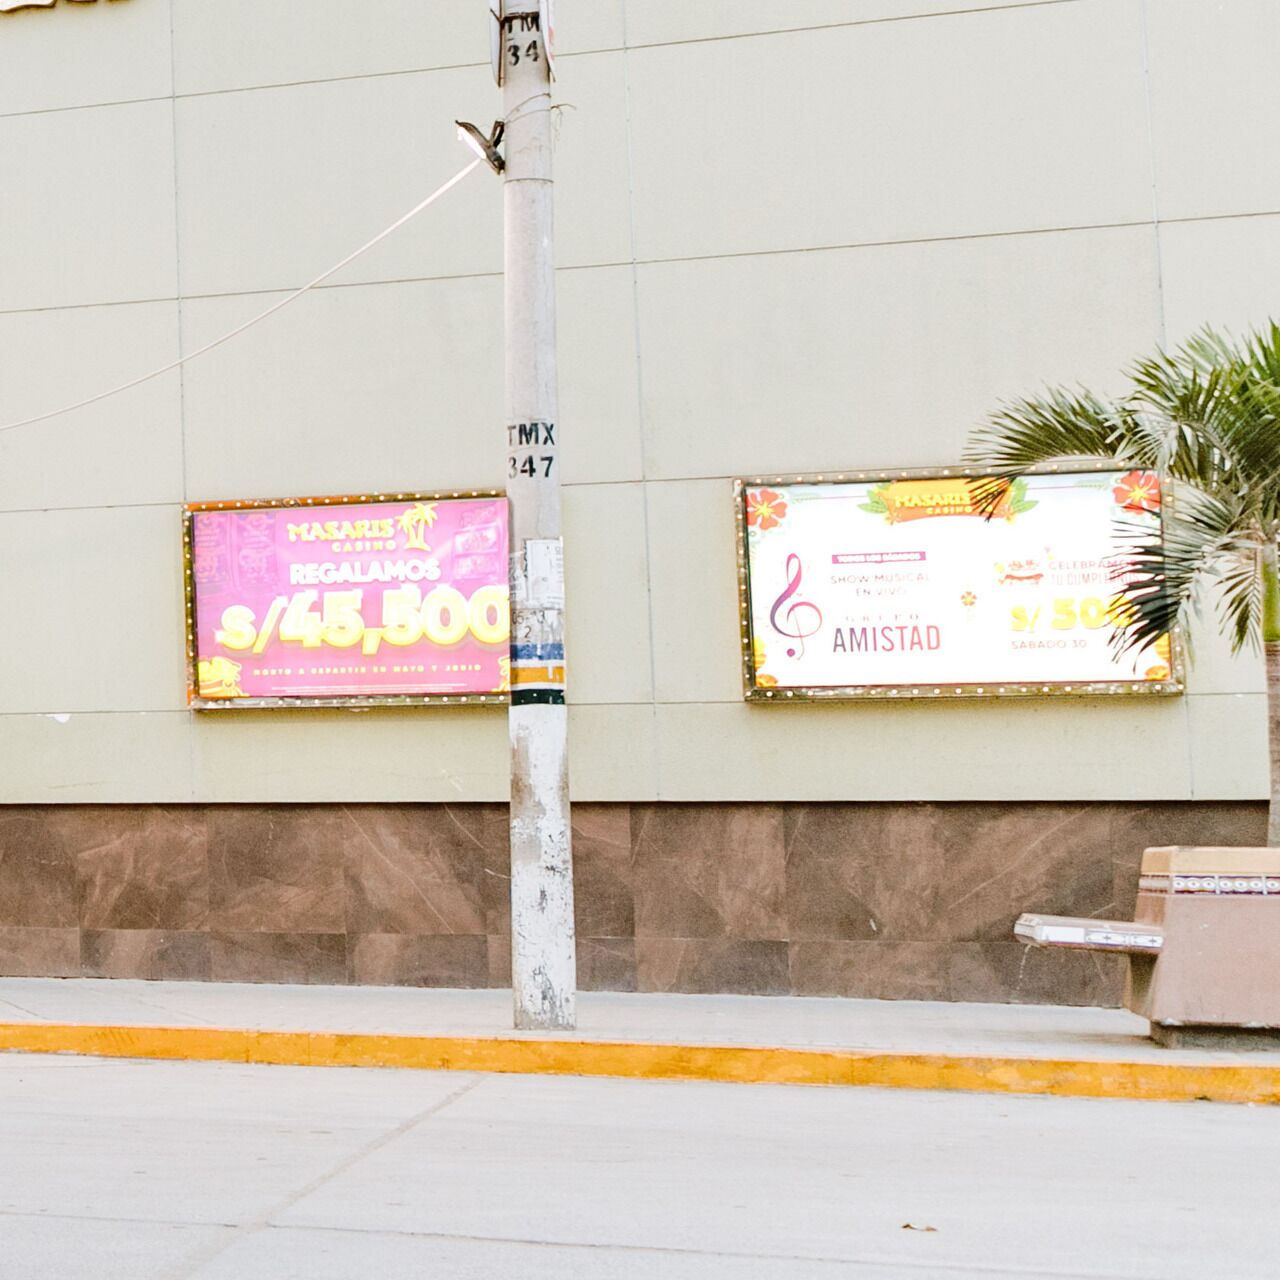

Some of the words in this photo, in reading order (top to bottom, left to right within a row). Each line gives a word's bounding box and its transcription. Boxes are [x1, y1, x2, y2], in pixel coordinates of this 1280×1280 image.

[507, 422, 555, 446] TMX
[508, 455, 554, 479] 347
[287, 518, 395, 542] MASARIS
[331, 540, 396, 553] CASINO
[290, 558, 441, 585] REGALAMOS
[833, 625, 941, 653] AMISTAD
